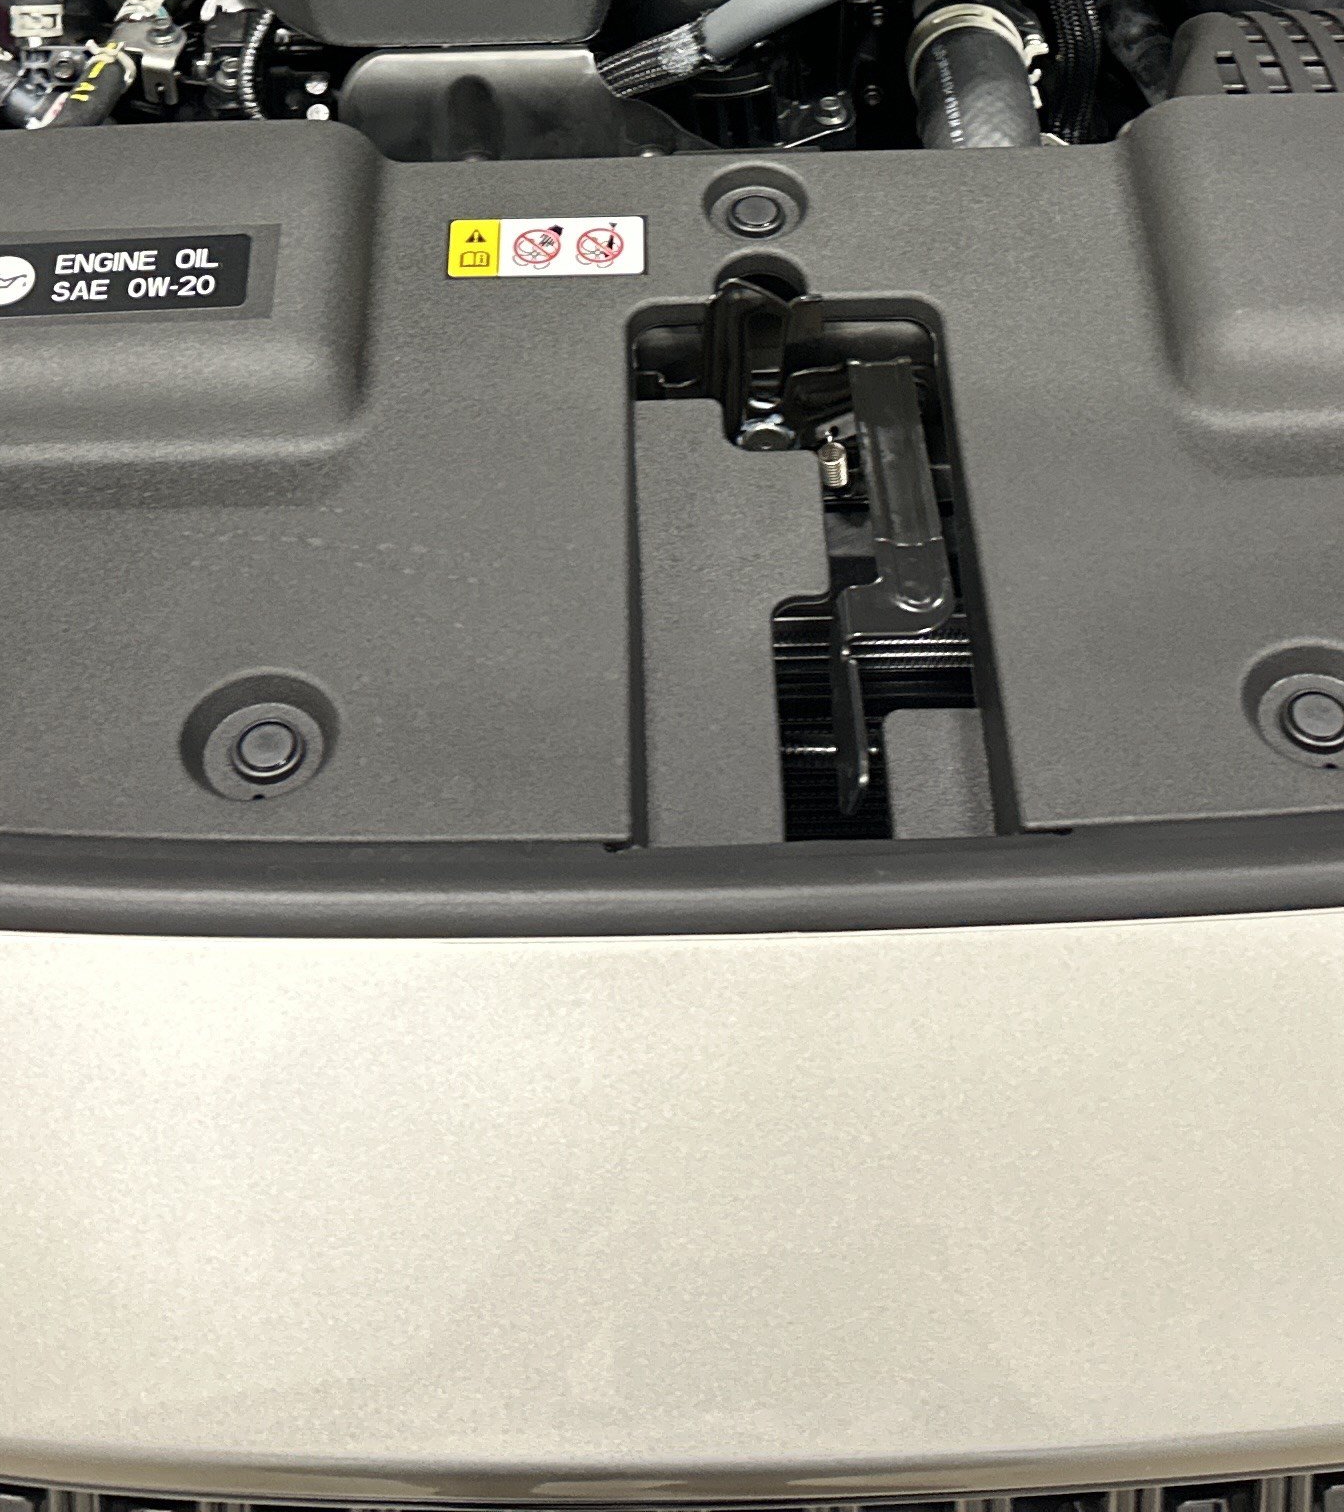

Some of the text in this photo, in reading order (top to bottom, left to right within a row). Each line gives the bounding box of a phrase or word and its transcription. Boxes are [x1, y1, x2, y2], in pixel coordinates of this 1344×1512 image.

[54, 248, 219, 275] ENGINE OIL
[51, 275, 216, 302] SAE 0W-20
